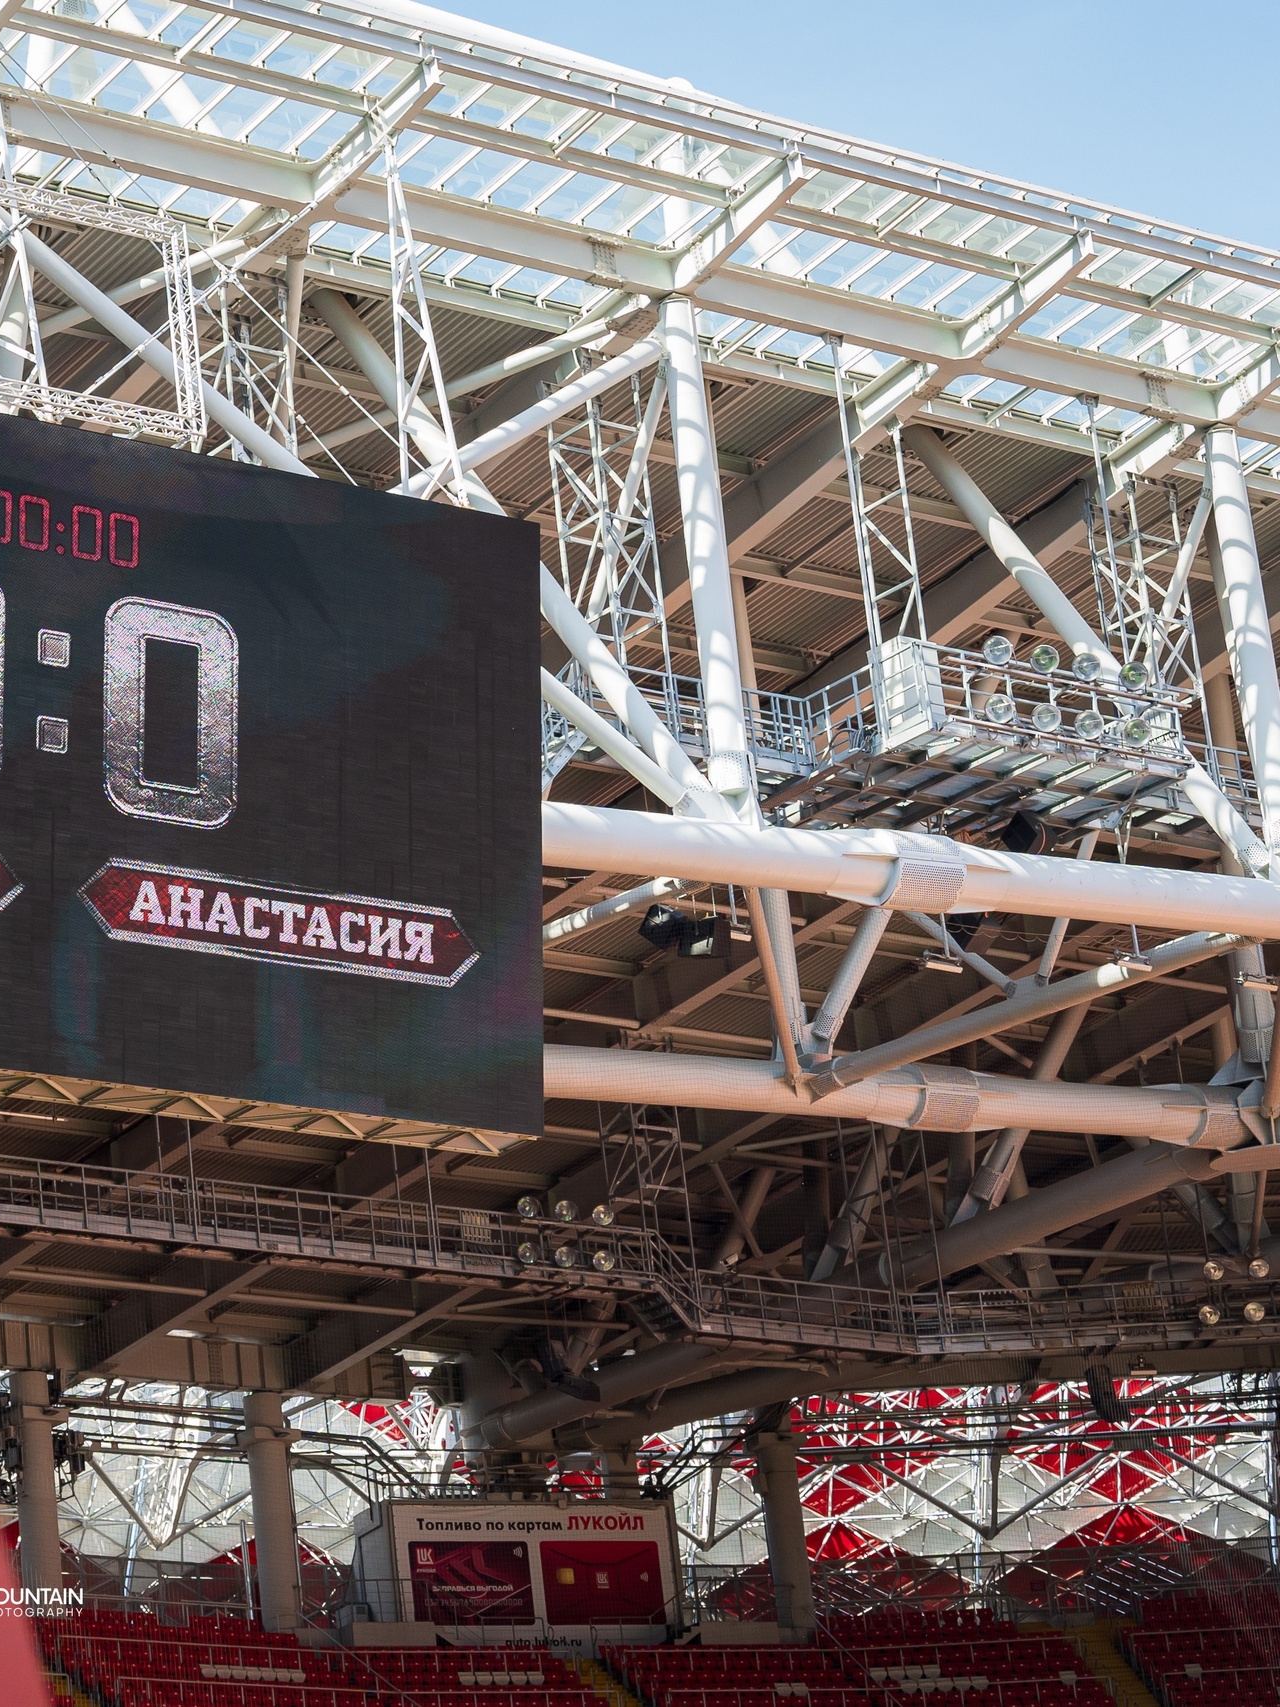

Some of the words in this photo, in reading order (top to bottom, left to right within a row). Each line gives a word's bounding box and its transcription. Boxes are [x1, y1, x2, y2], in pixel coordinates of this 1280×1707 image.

[129, 880, 435, 964] АНАСТАСИЯ
[416, 1517, 482, 1531] Топливо
[486, 1520, 504, 1531] по
[508, 1520, 563, 1534] картам
[567, 1512, 644, 1531] ЛУКОЙЛ
[476, 1584, 514, 1592] ВЫГОДОЙ
